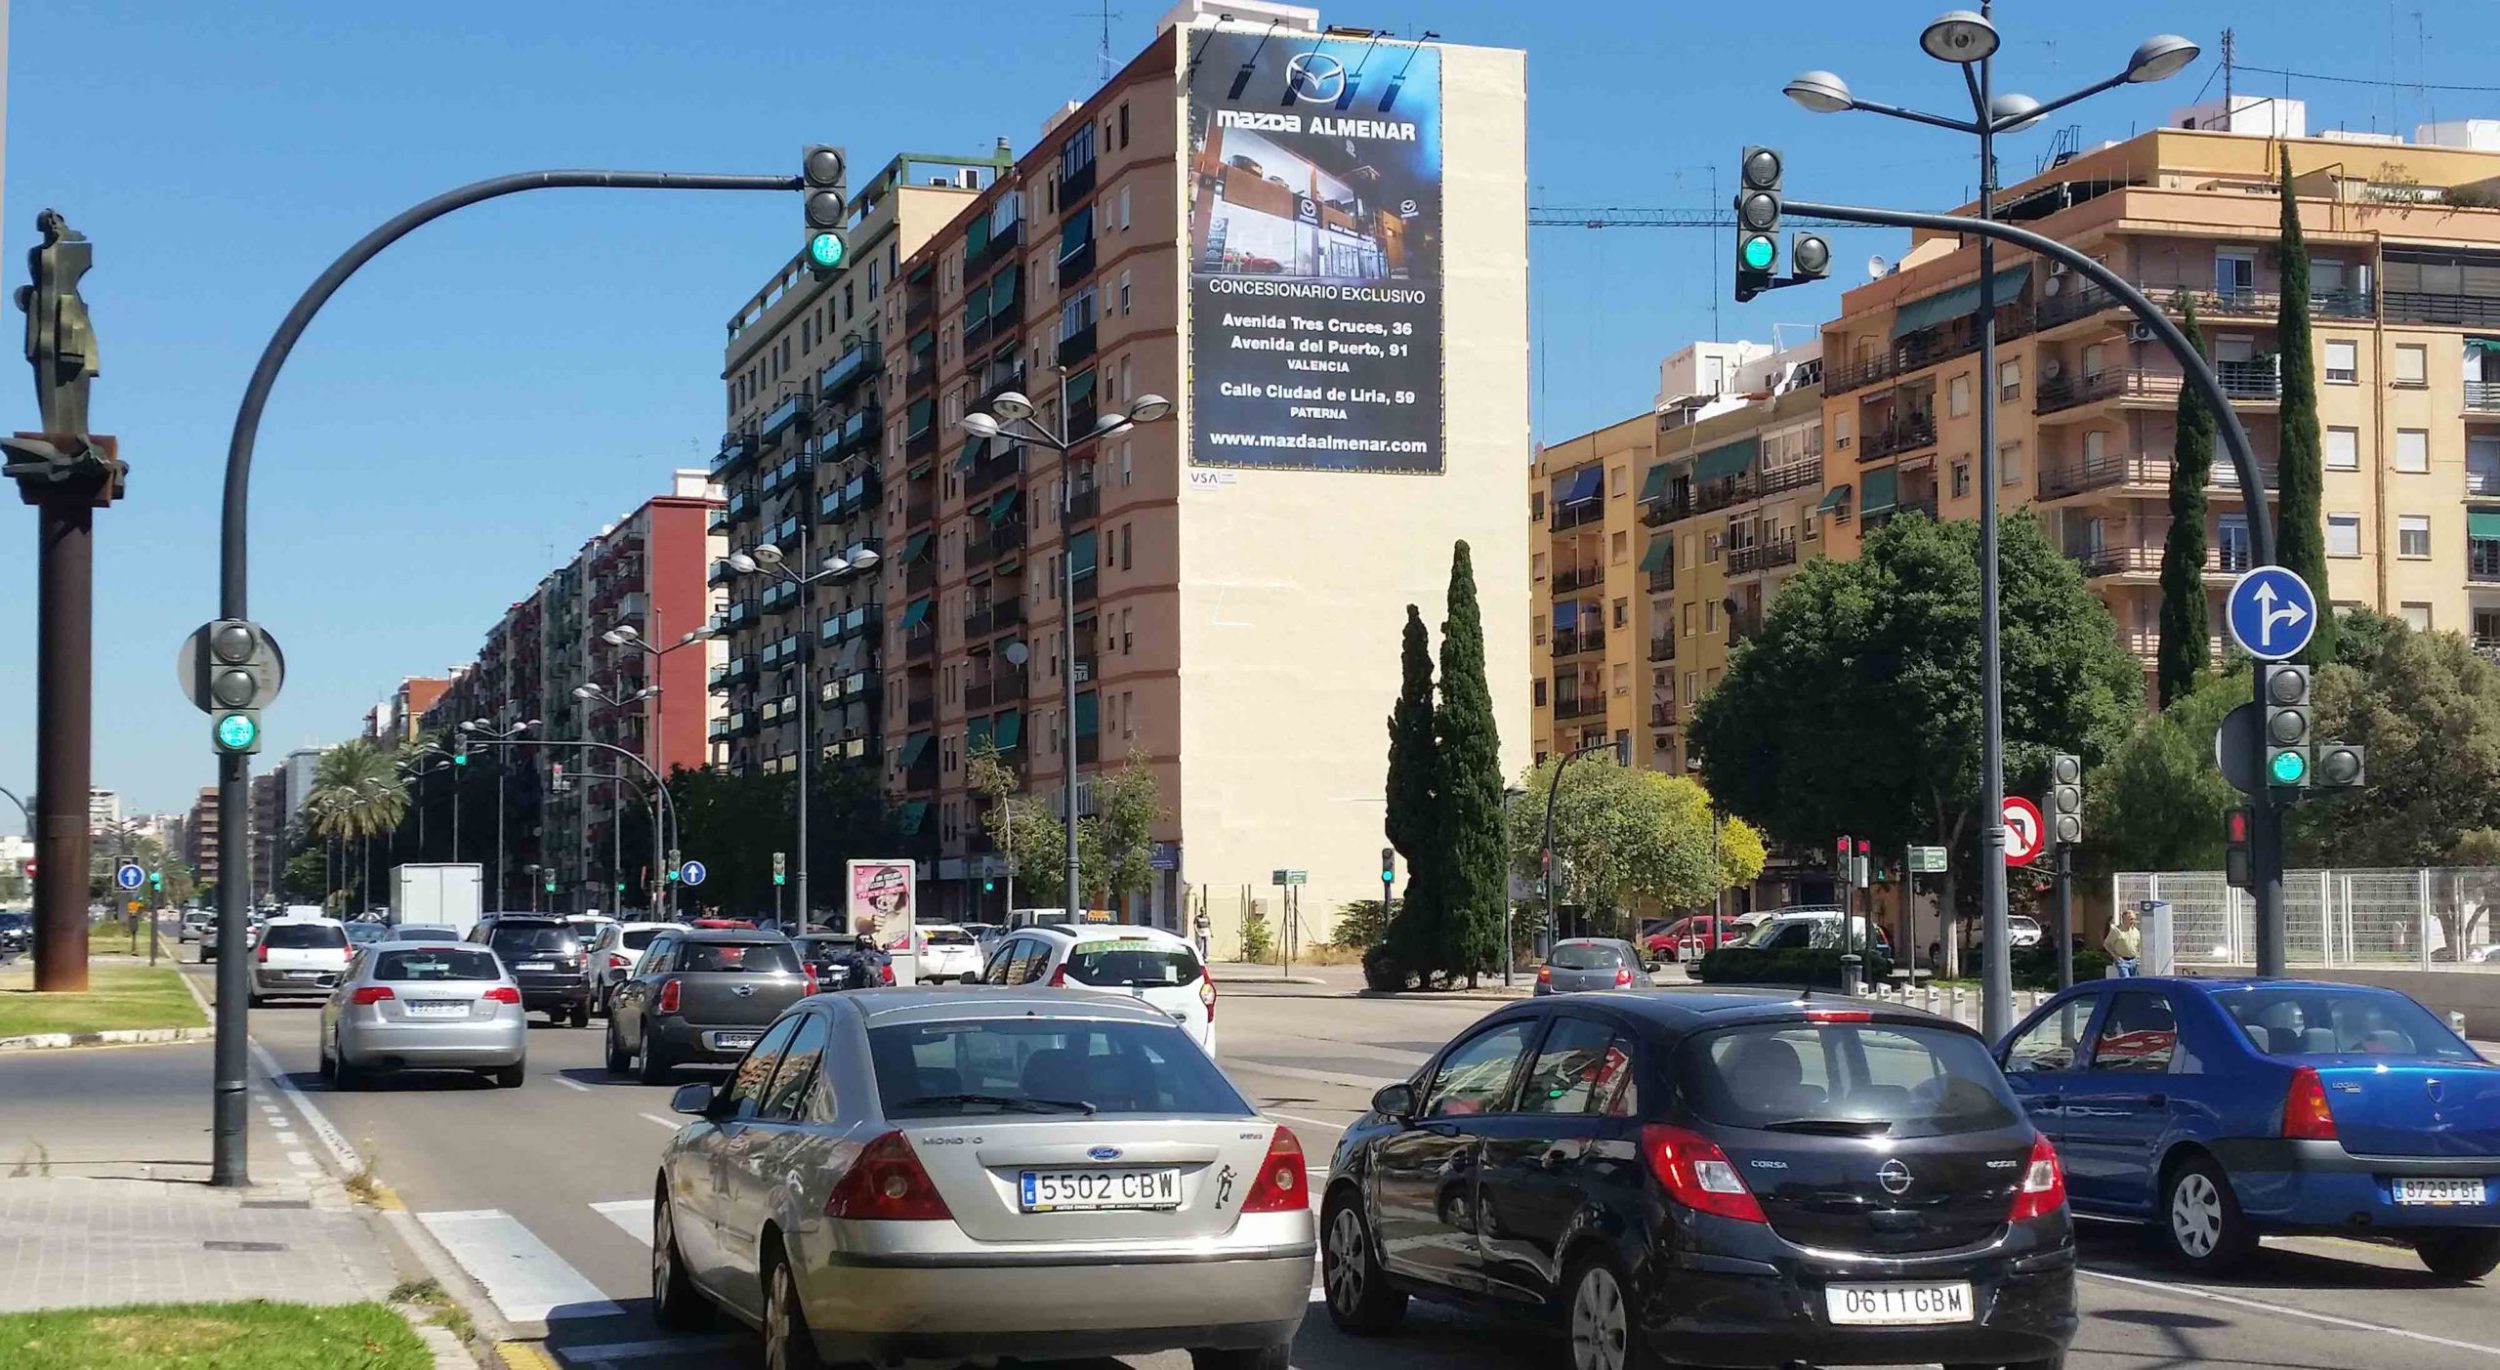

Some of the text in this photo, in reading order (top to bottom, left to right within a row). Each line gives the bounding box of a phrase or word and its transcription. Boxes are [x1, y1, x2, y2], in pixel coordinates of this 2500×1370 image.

[1309, 116, 1416, 141] ALMENAR
[1209, 279, 1425, 304] CONCESIONARIO EXCLUSIVO
[1222, 313, 1412, 336] Avenida Tres Cruces, 36
[1230, 336, 1408, 358] Avenida del Puerto, 91
[1287, 359, 1350, 373] VALENCIA
[1220, 382, 1415, 405] Calle Ciudad de Liria, 59
[1290, 407, 1347, 420] PATERNA
[1210, 433, 1428, 453] www.mazdaalmenar.com
[1751, 1160, 1789, 1169] CORSA
[1042, 1172, 1172, 1200] 5502 CBW
